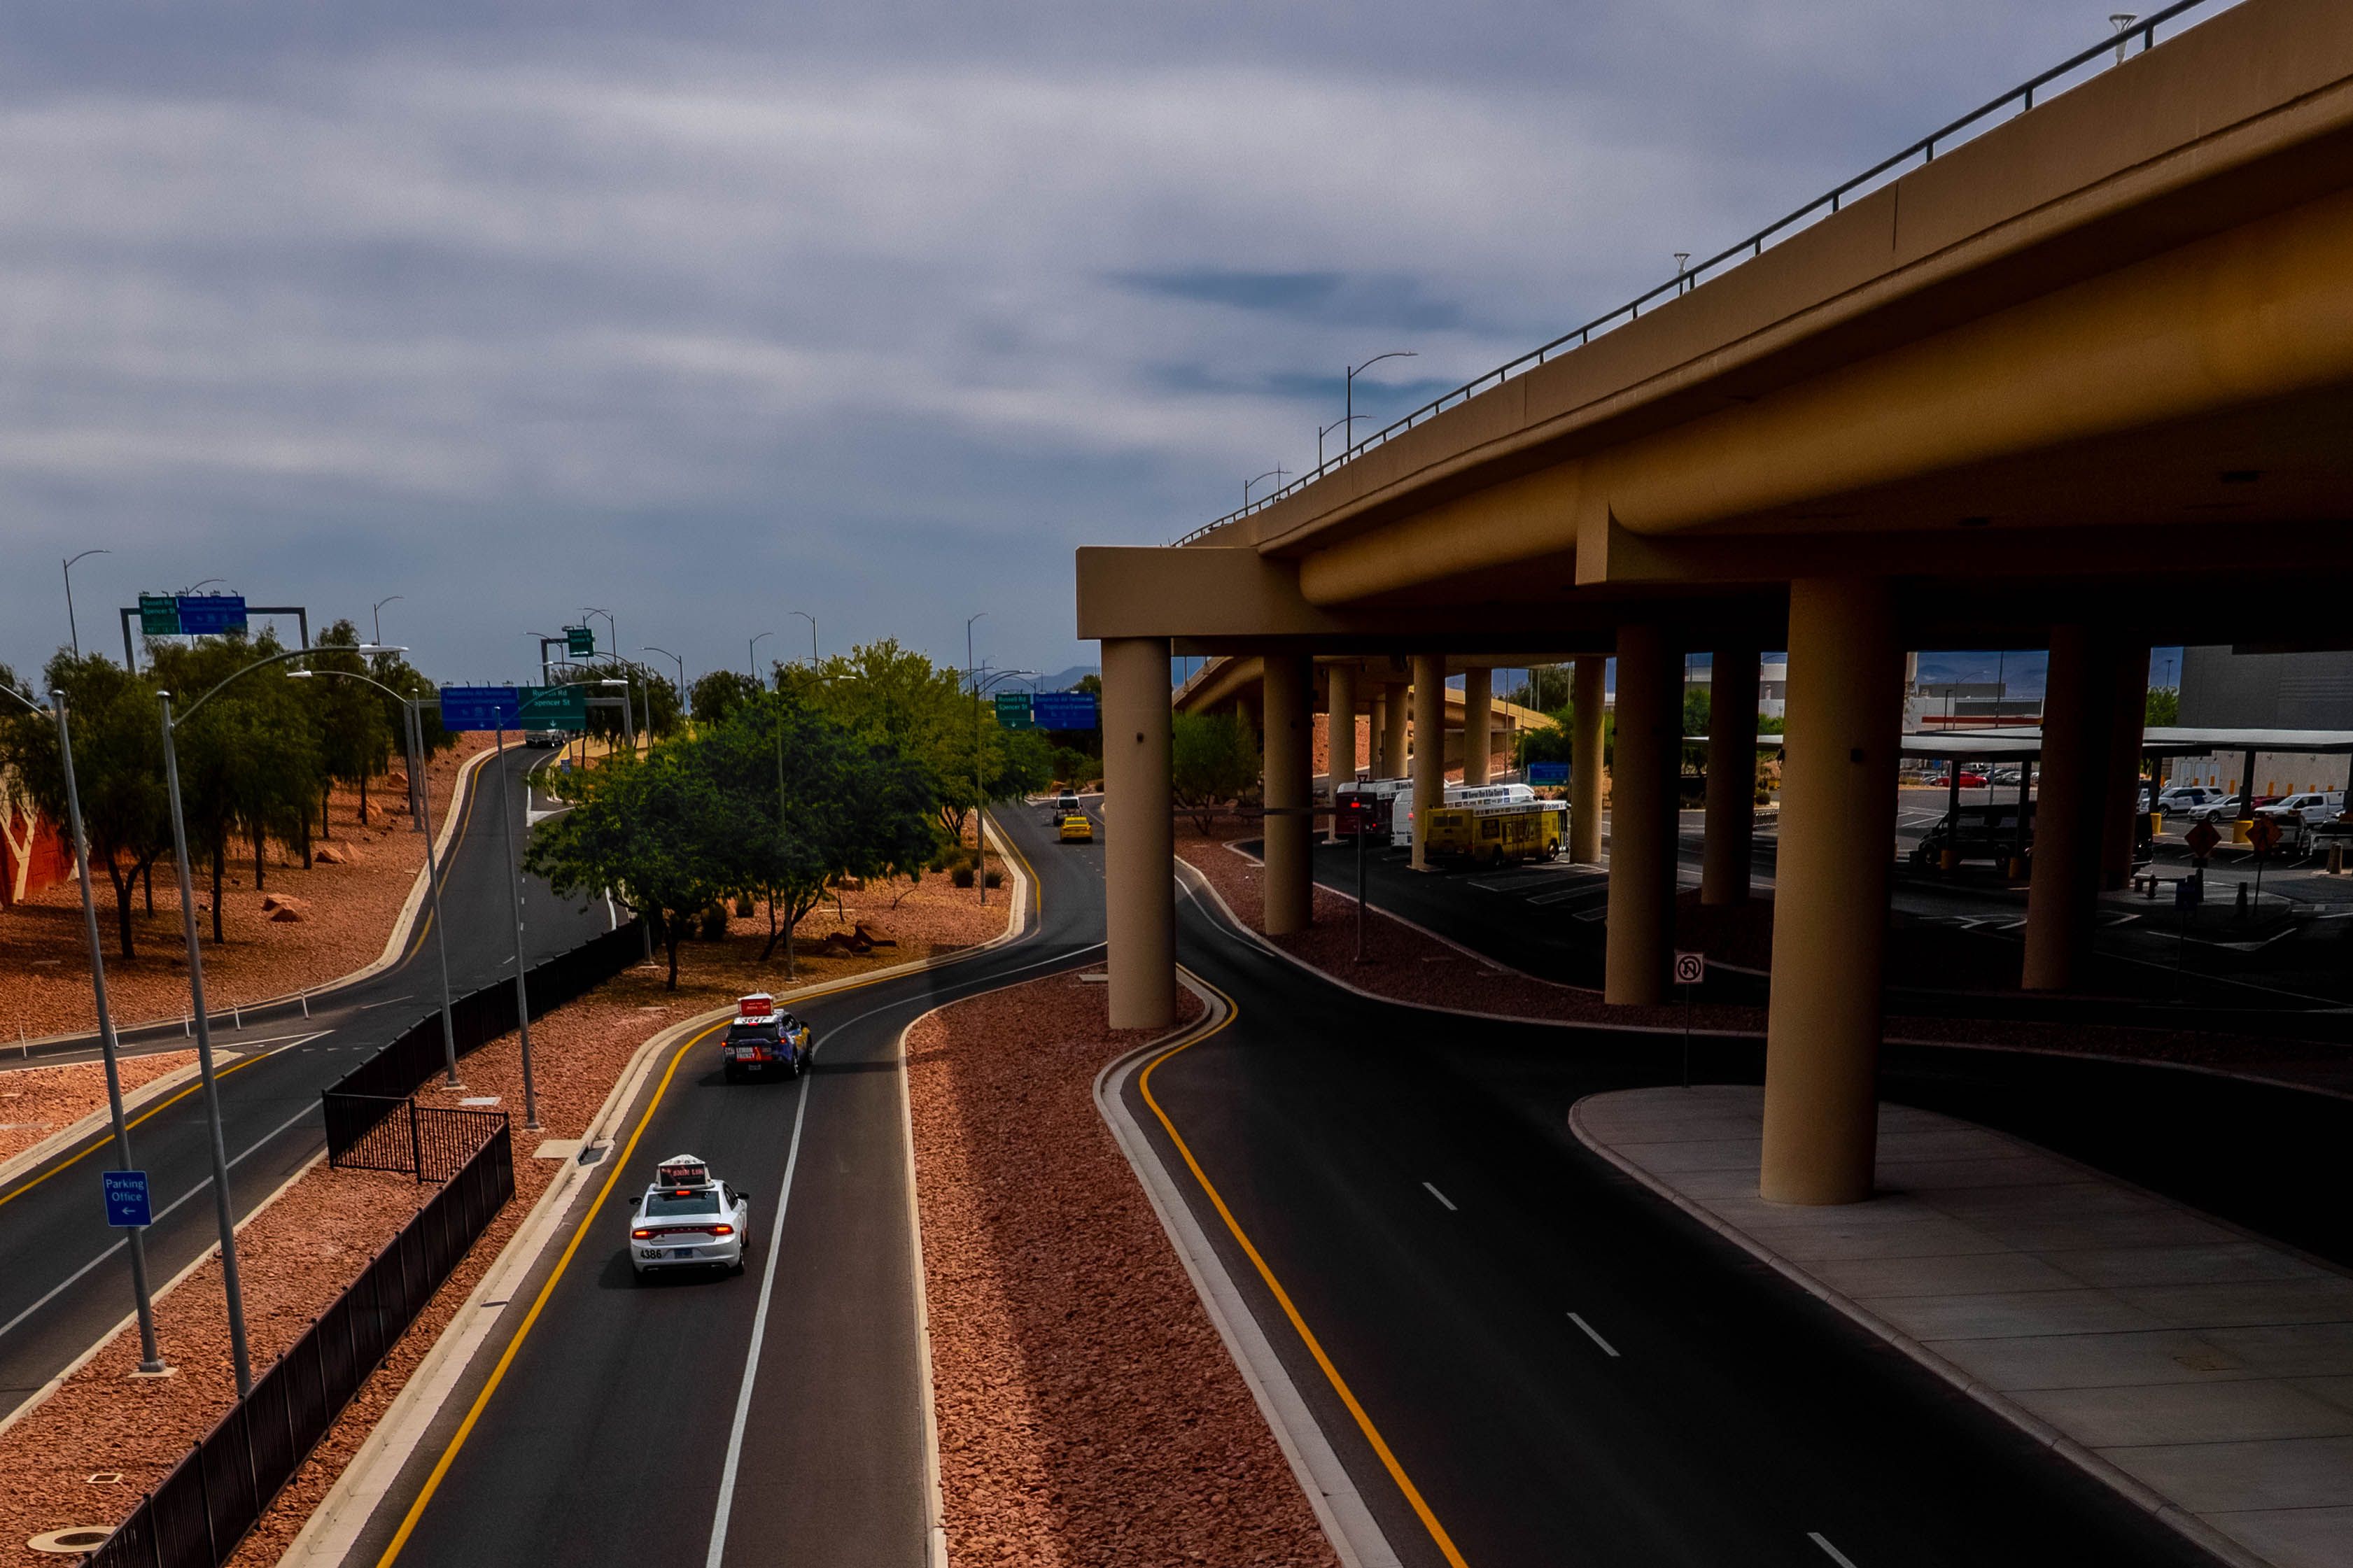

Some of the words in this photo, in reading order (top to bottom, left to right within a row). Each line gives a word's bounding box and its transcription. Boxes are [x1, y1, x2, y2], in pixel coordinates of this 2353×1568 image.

[106, 1178, 144, 1190] Parking
[112, 1192, 142, 1201] Office
[640, 1249, 662, 1259] 4386
